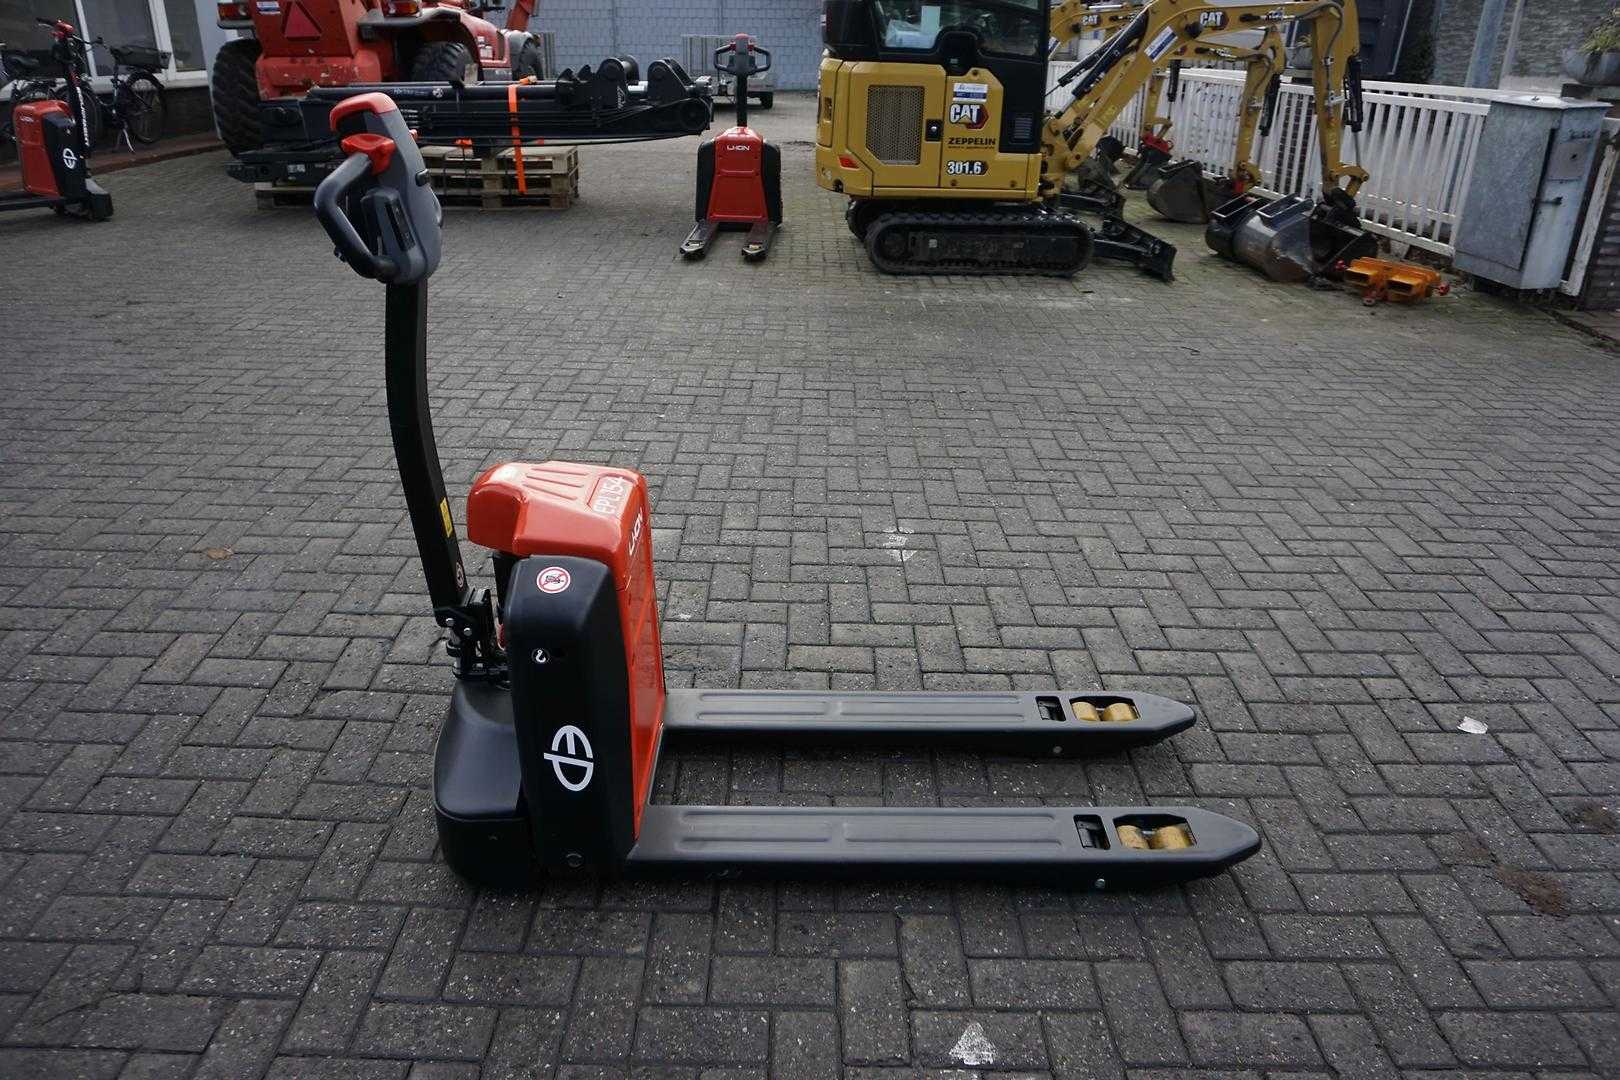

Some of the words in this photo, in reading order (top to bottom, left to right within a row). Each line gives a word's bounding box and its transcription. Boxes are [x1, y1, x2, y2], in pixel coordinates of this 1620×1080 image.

[1082, 14, 1098, 26] CAT
[1200, 11, 1223, 27] CAT
[949, 103, 980, 124] CAT
[948, 137, 996, 145] ZEPPELIN
[947, 161, 982, 175] 301.6
